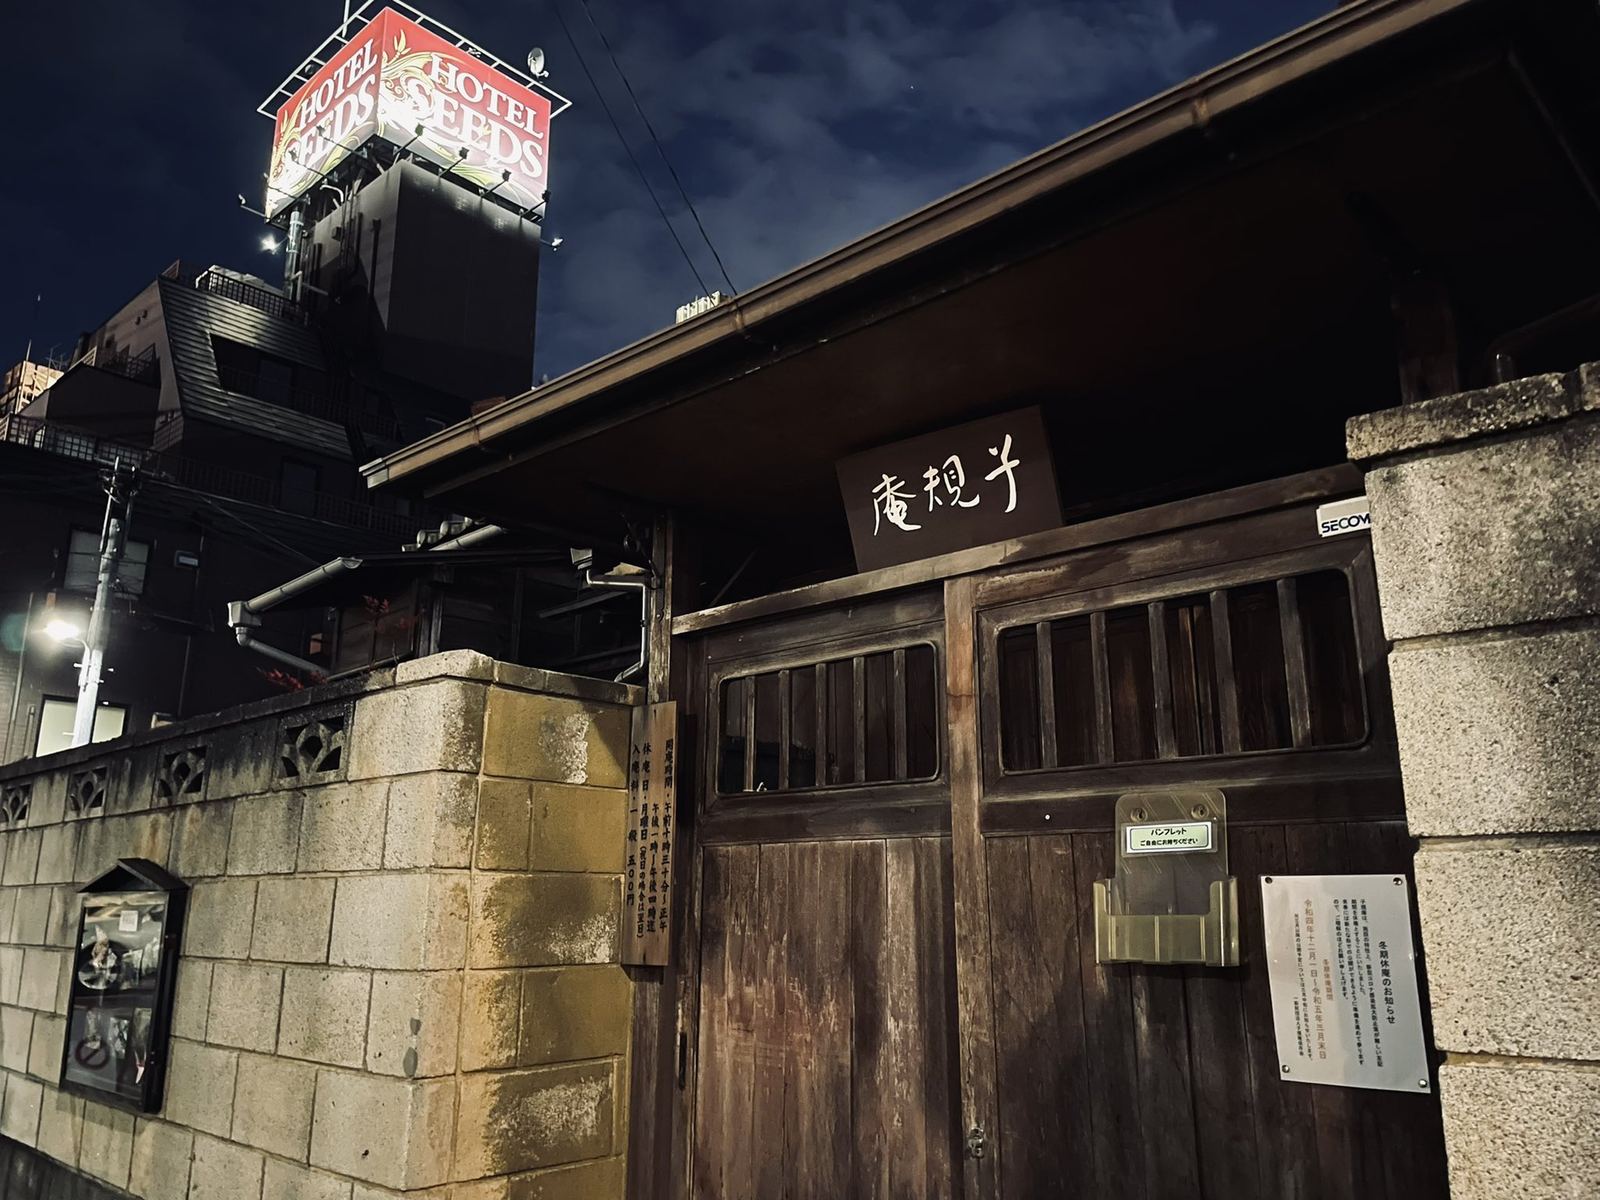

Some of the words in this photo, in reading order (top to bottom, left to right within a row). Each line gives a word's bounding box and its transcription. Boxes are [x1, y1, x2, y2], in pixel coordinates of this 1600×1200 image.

[299, 38, 378, 130] HOTEL
[430, 52, 544, 140] HOTEL
[405, 77, 544, 178] SEEDS
[1321, 513, 1371, 534] SECOM
[1140, 837, 1199, 847] ご自由にお持ちください
[1150, 827, 1187, 836] パンフレット
[1378, 940, 1396, 1025] 冬期休庵のお知らせ
